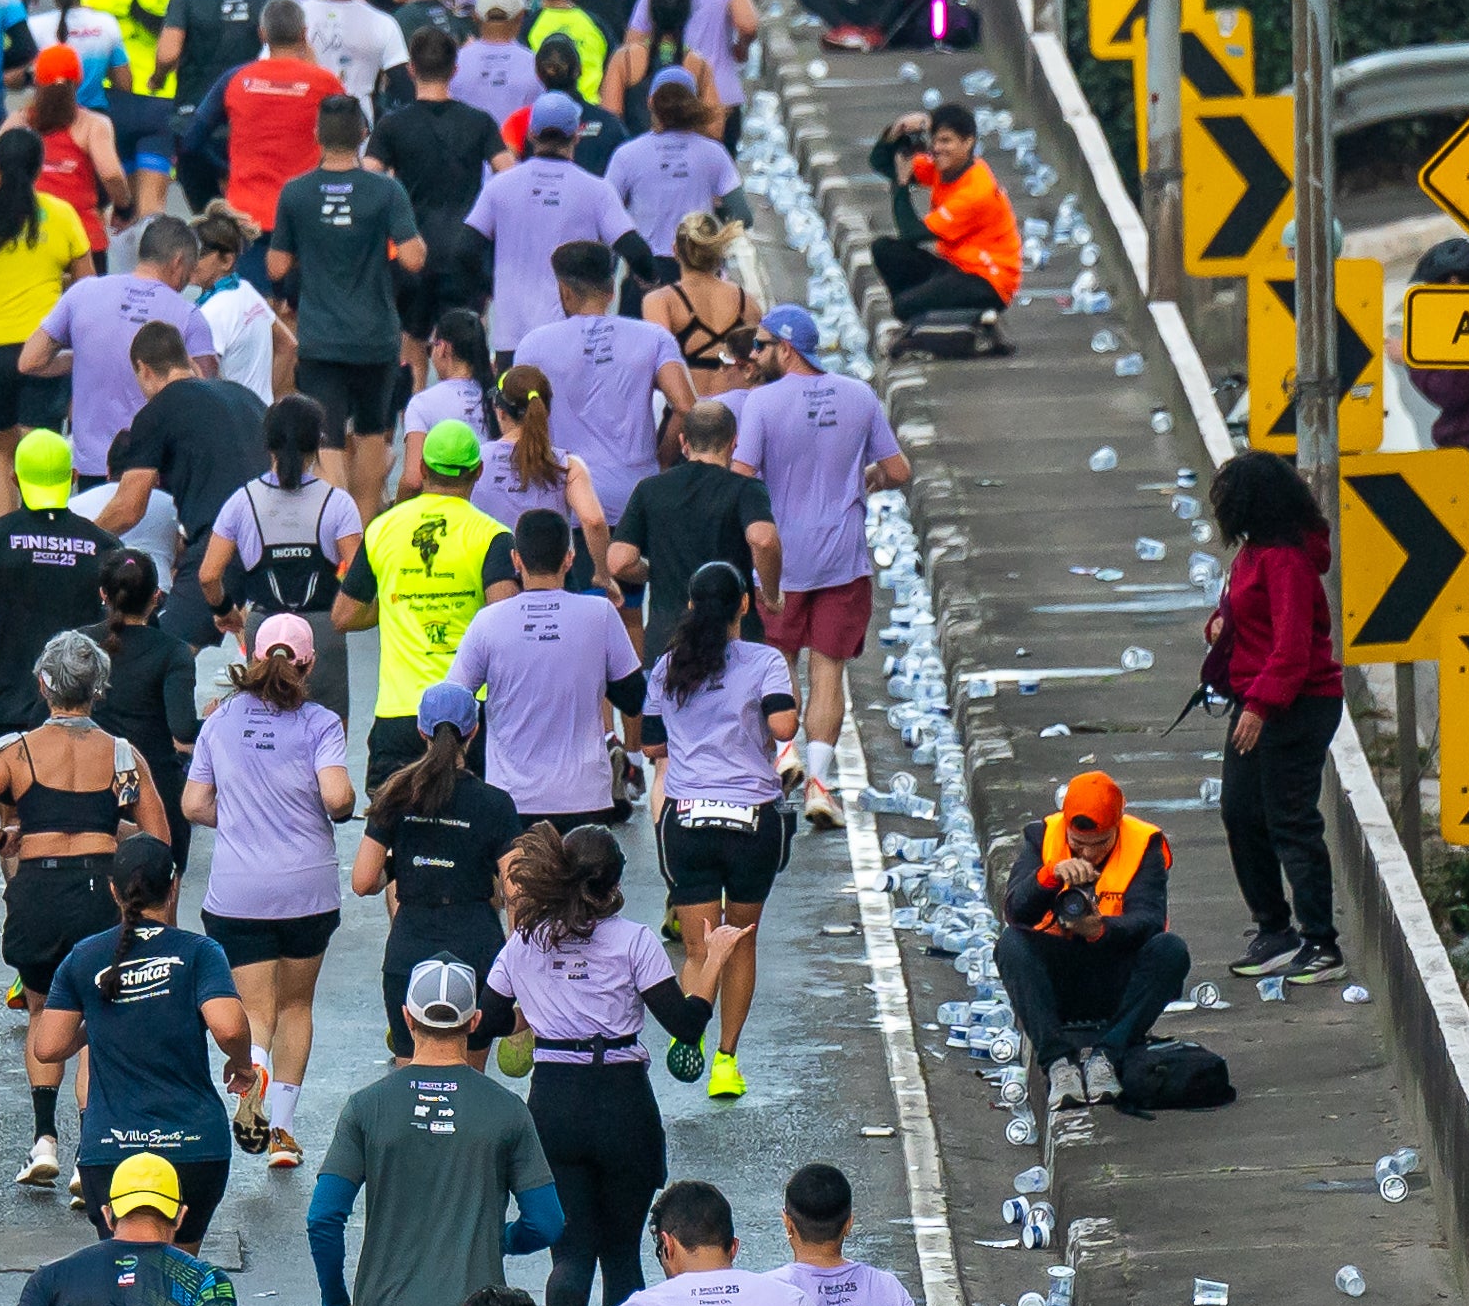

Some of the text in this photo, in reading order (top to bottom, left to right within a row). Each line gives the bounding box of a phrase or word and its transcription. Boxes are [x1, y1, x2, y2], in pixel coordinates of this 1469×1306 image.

[9, 534, 97, 556] FINISHER
[59, 553, 77, 567] 25
[120, 964, 170, 986] stintas
[442, 1081, 459, 1092] 25
[724, 1284, 741, 1295] 25
[843, 1281, 859, 1294] 25
